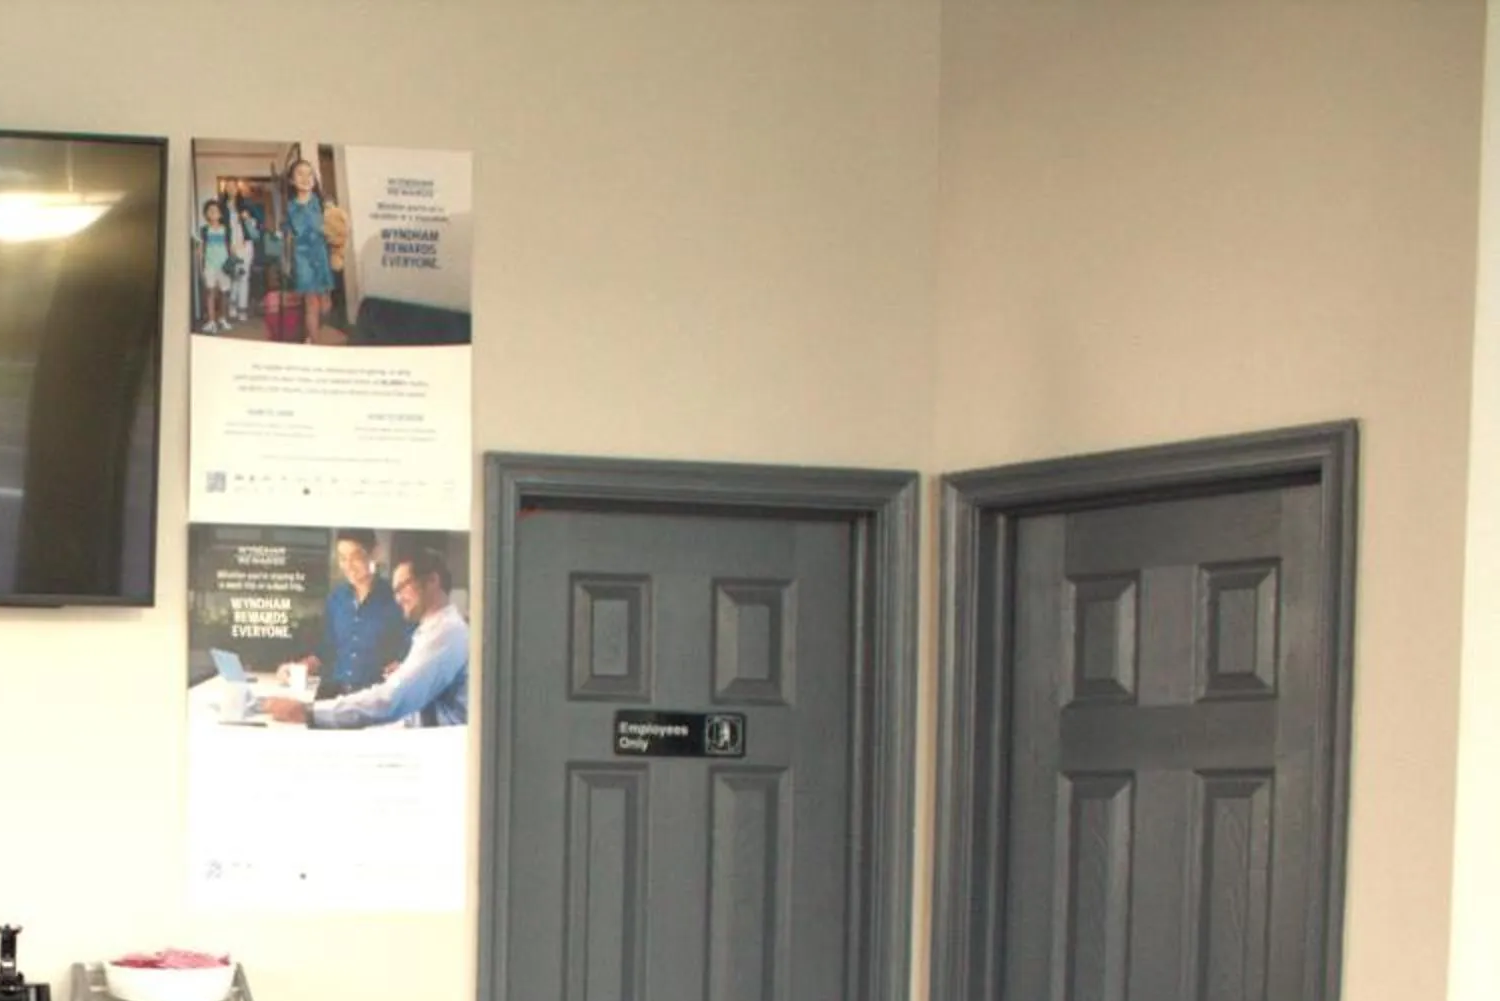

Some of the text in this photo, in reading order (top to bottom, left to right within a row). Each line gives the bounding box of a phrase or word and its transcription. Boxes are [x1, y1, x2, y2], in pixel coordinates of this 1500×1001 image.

[230, 597, 291, 610] WYNDHAM
[233, 611, 289, 624] REWARDS
[231, 625, 293, 638] EVERYONE.
[619, 721, 689, 738] Employees
[619, 737, 649, 752] Only
